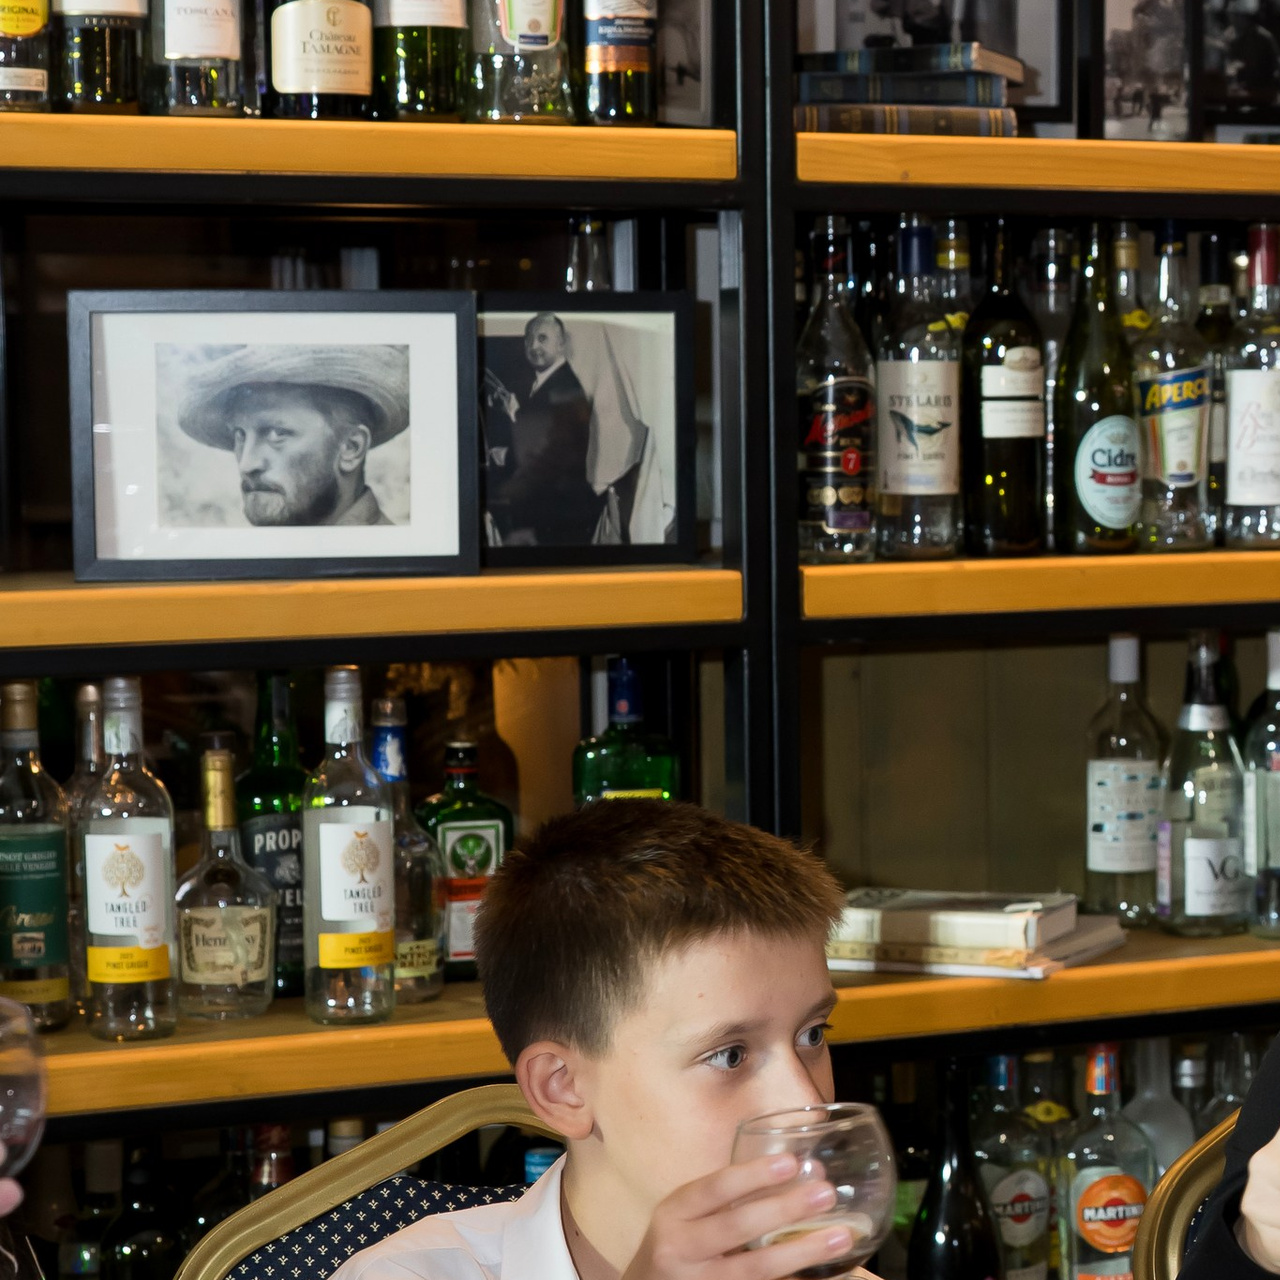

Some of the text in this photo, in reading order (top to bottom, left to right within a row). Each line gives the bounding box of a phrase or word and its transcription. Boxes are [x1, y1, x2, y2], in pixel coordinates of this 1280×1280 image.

[343, 885, 383, 901] TANGLED
[105, 901, 148, 915] TANGLED
[353, 901, 375, 914] TREE
[115, 916, 138, 929] TREE
